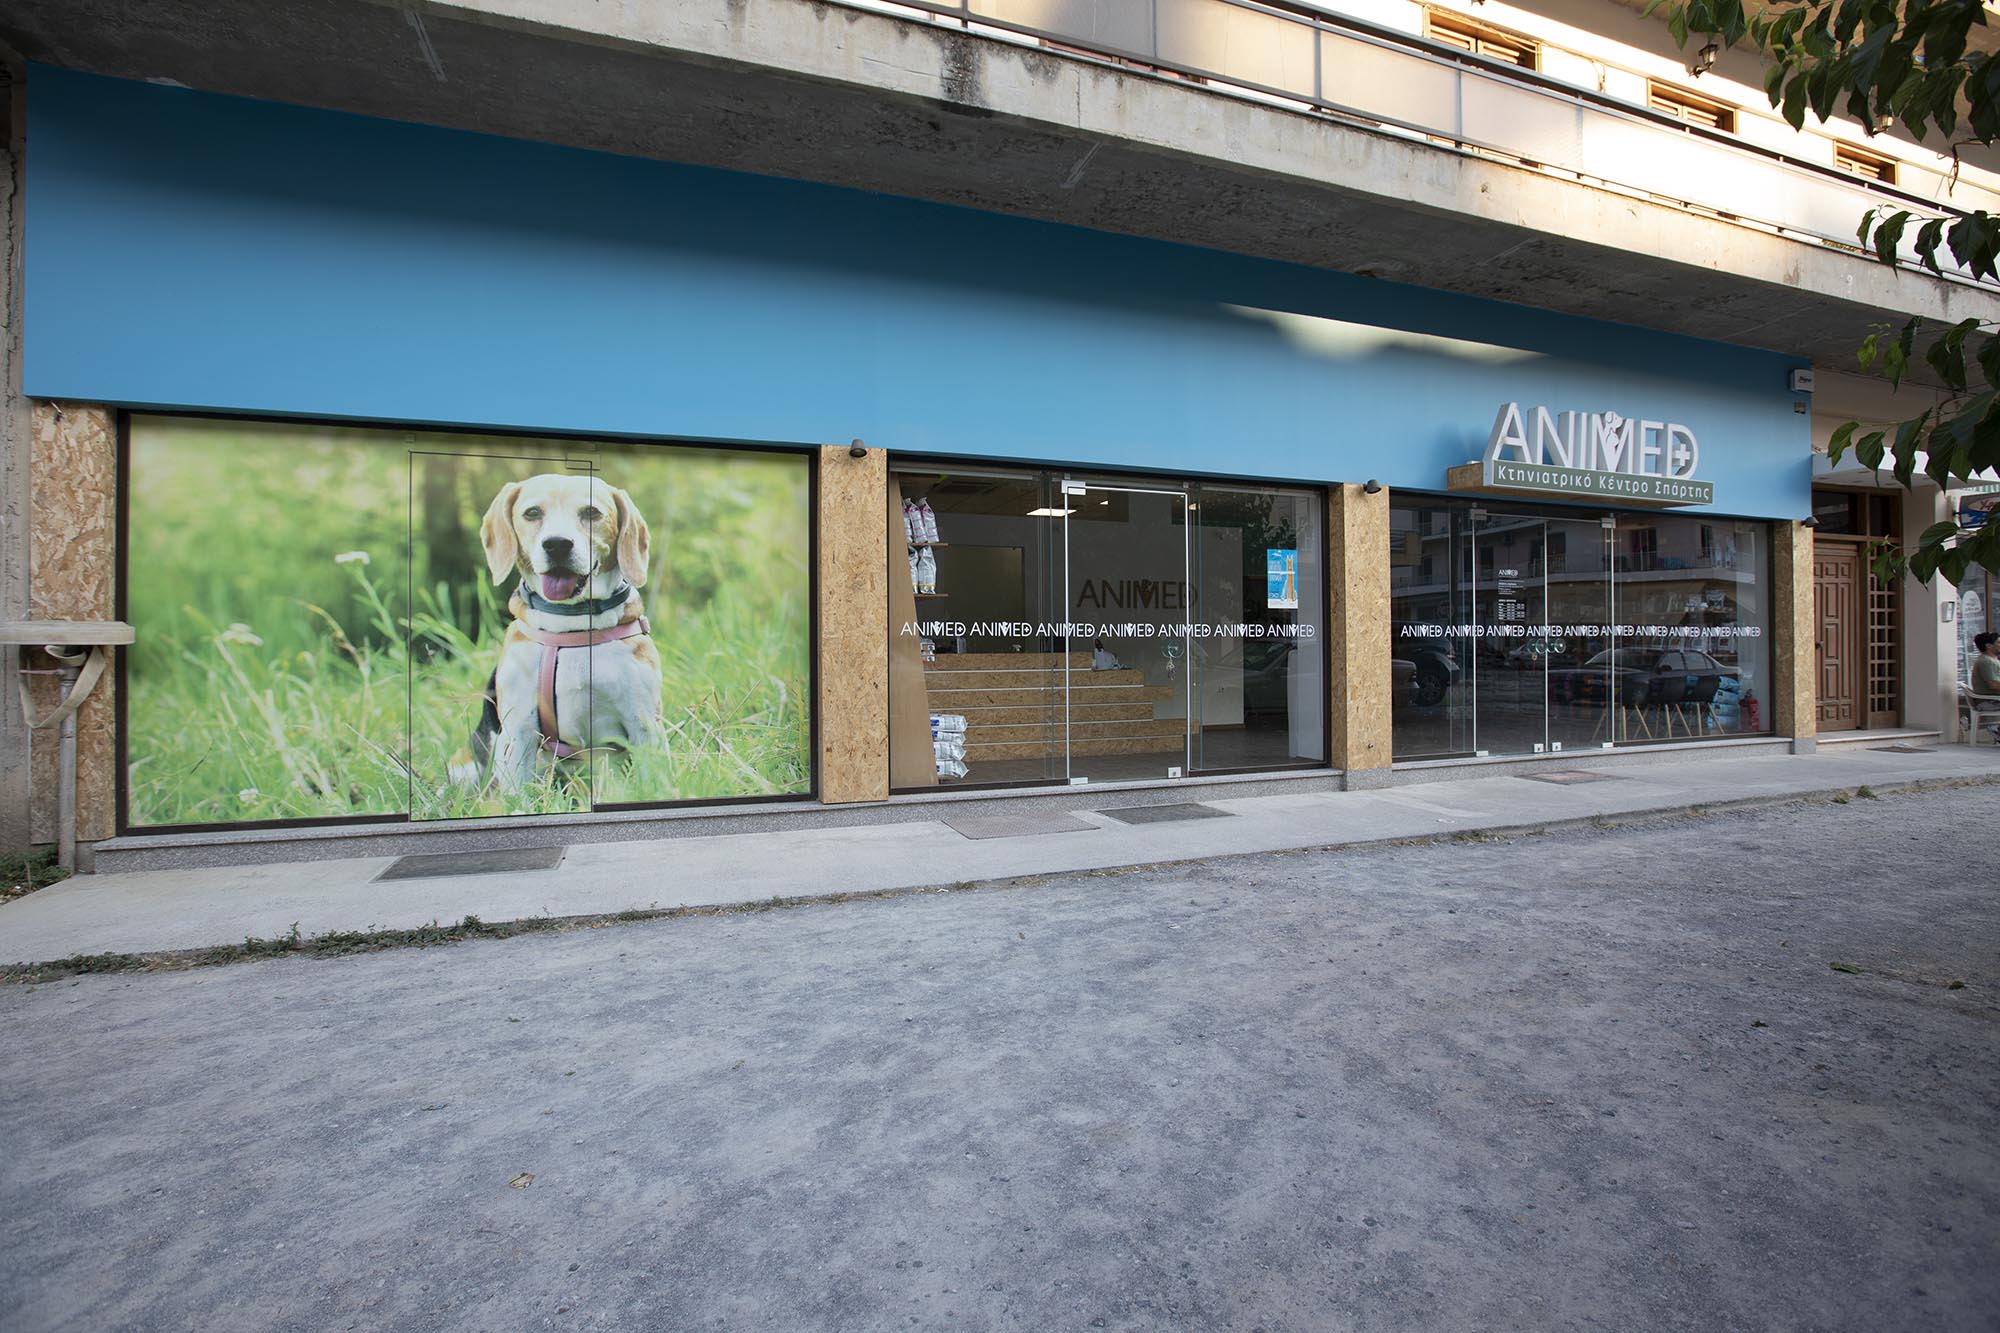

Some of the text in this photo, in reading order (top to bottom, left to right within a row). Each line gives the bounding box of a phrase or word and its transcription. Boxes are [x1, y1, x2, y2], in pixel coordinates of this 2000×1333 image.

[1490, 402, 1699, 480] ANIMED
[1498, 465, 1710, 500] Κτηνιατρικό Κέντρο Σπάρτης
[1076, 578, 1199, 609] ANIMED
[900, 621, 1315, 638] ANIMED ANIMED ANIMED ANIMED ANIMED ANIMED ANIMED
[1400, 625, 1442, 637] ANIMED
[1445, 625, 1485, 637] ANIMED
[1486, 625, 1525, 637] ANIMED
[1526, 625, 1563, 637] ANIMED
[1564, 625, 1599, 637] ANIMED
[1600, 625, 1634, 637] ANIMED
[1635, 625, 1668, 637] ANIMED
